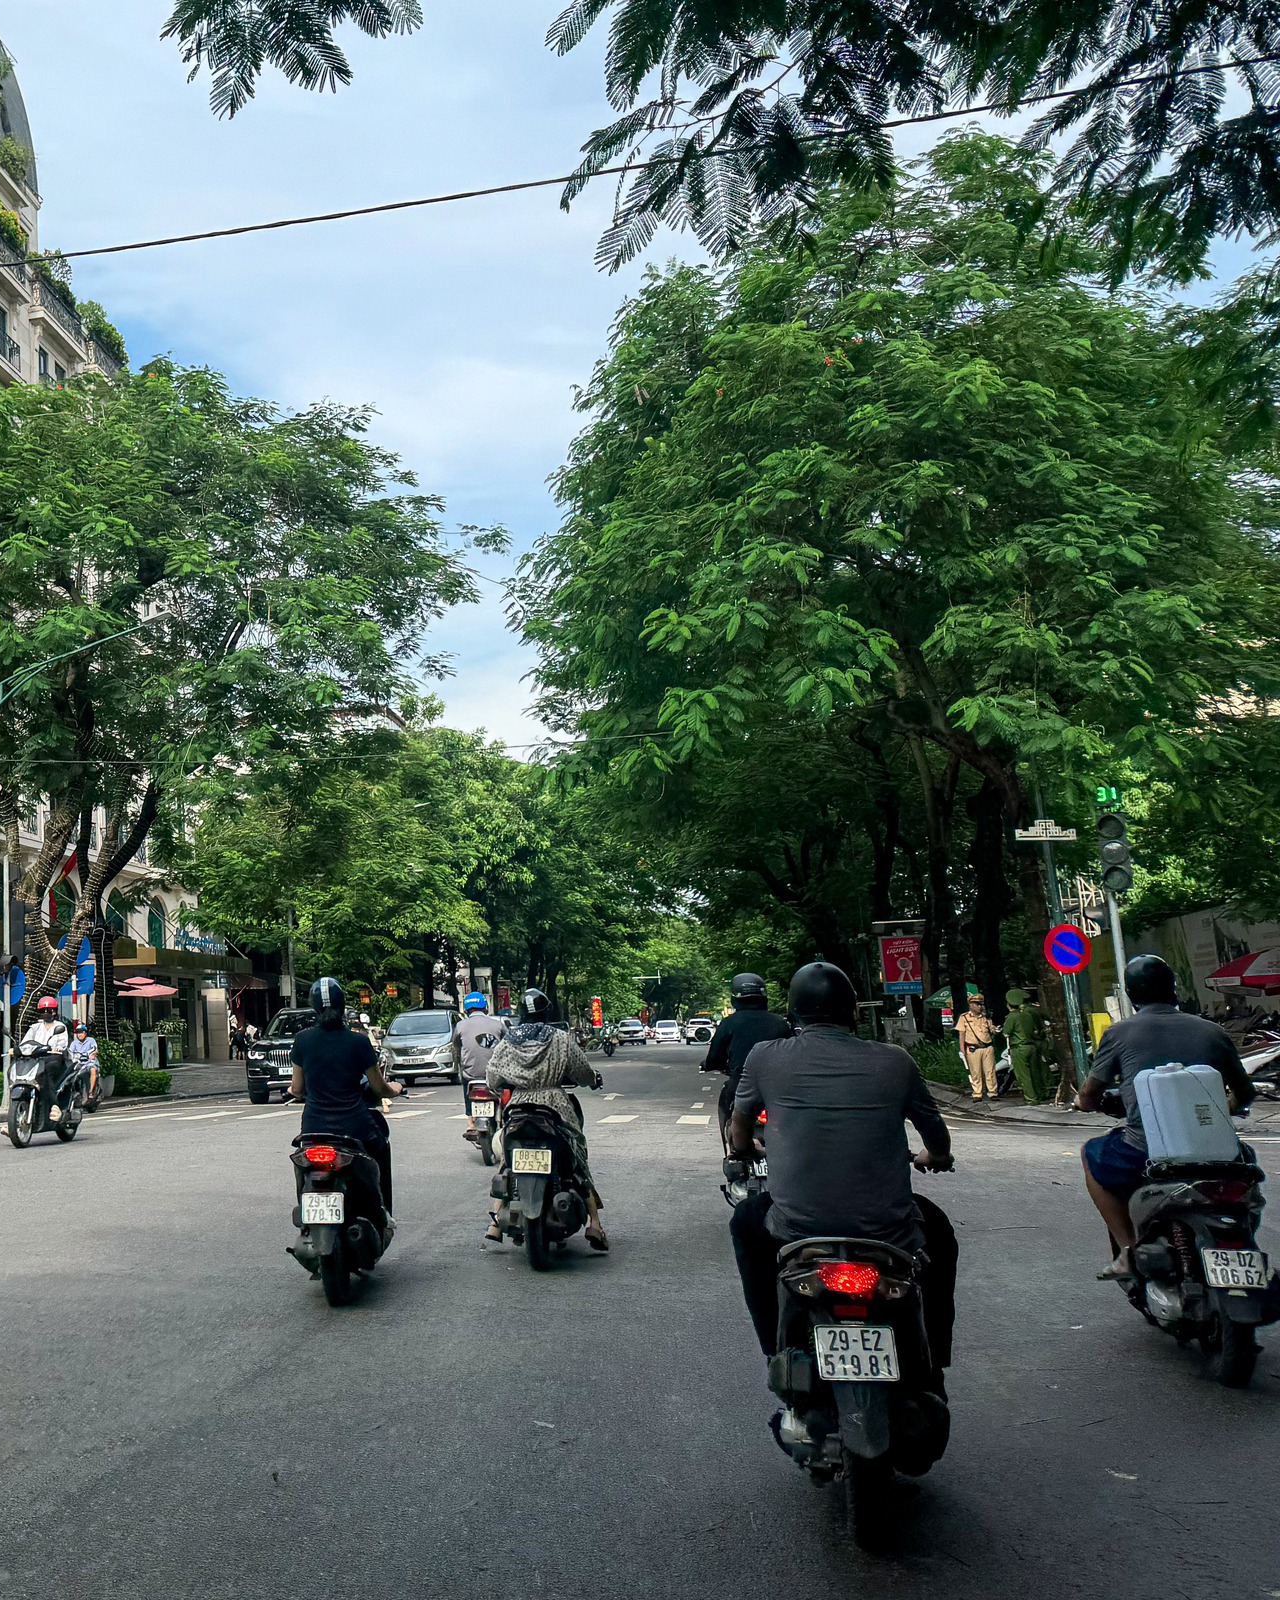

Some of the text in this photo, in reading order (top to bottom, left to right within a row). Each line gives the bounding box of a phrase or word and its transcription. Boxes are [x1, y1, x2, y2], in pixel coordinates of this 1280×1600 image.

[1097, 786, 1117, 801] 31
[827, 1329, 884, 1351] 29-E2
[824, 1353, 893, 1376] 519.81
